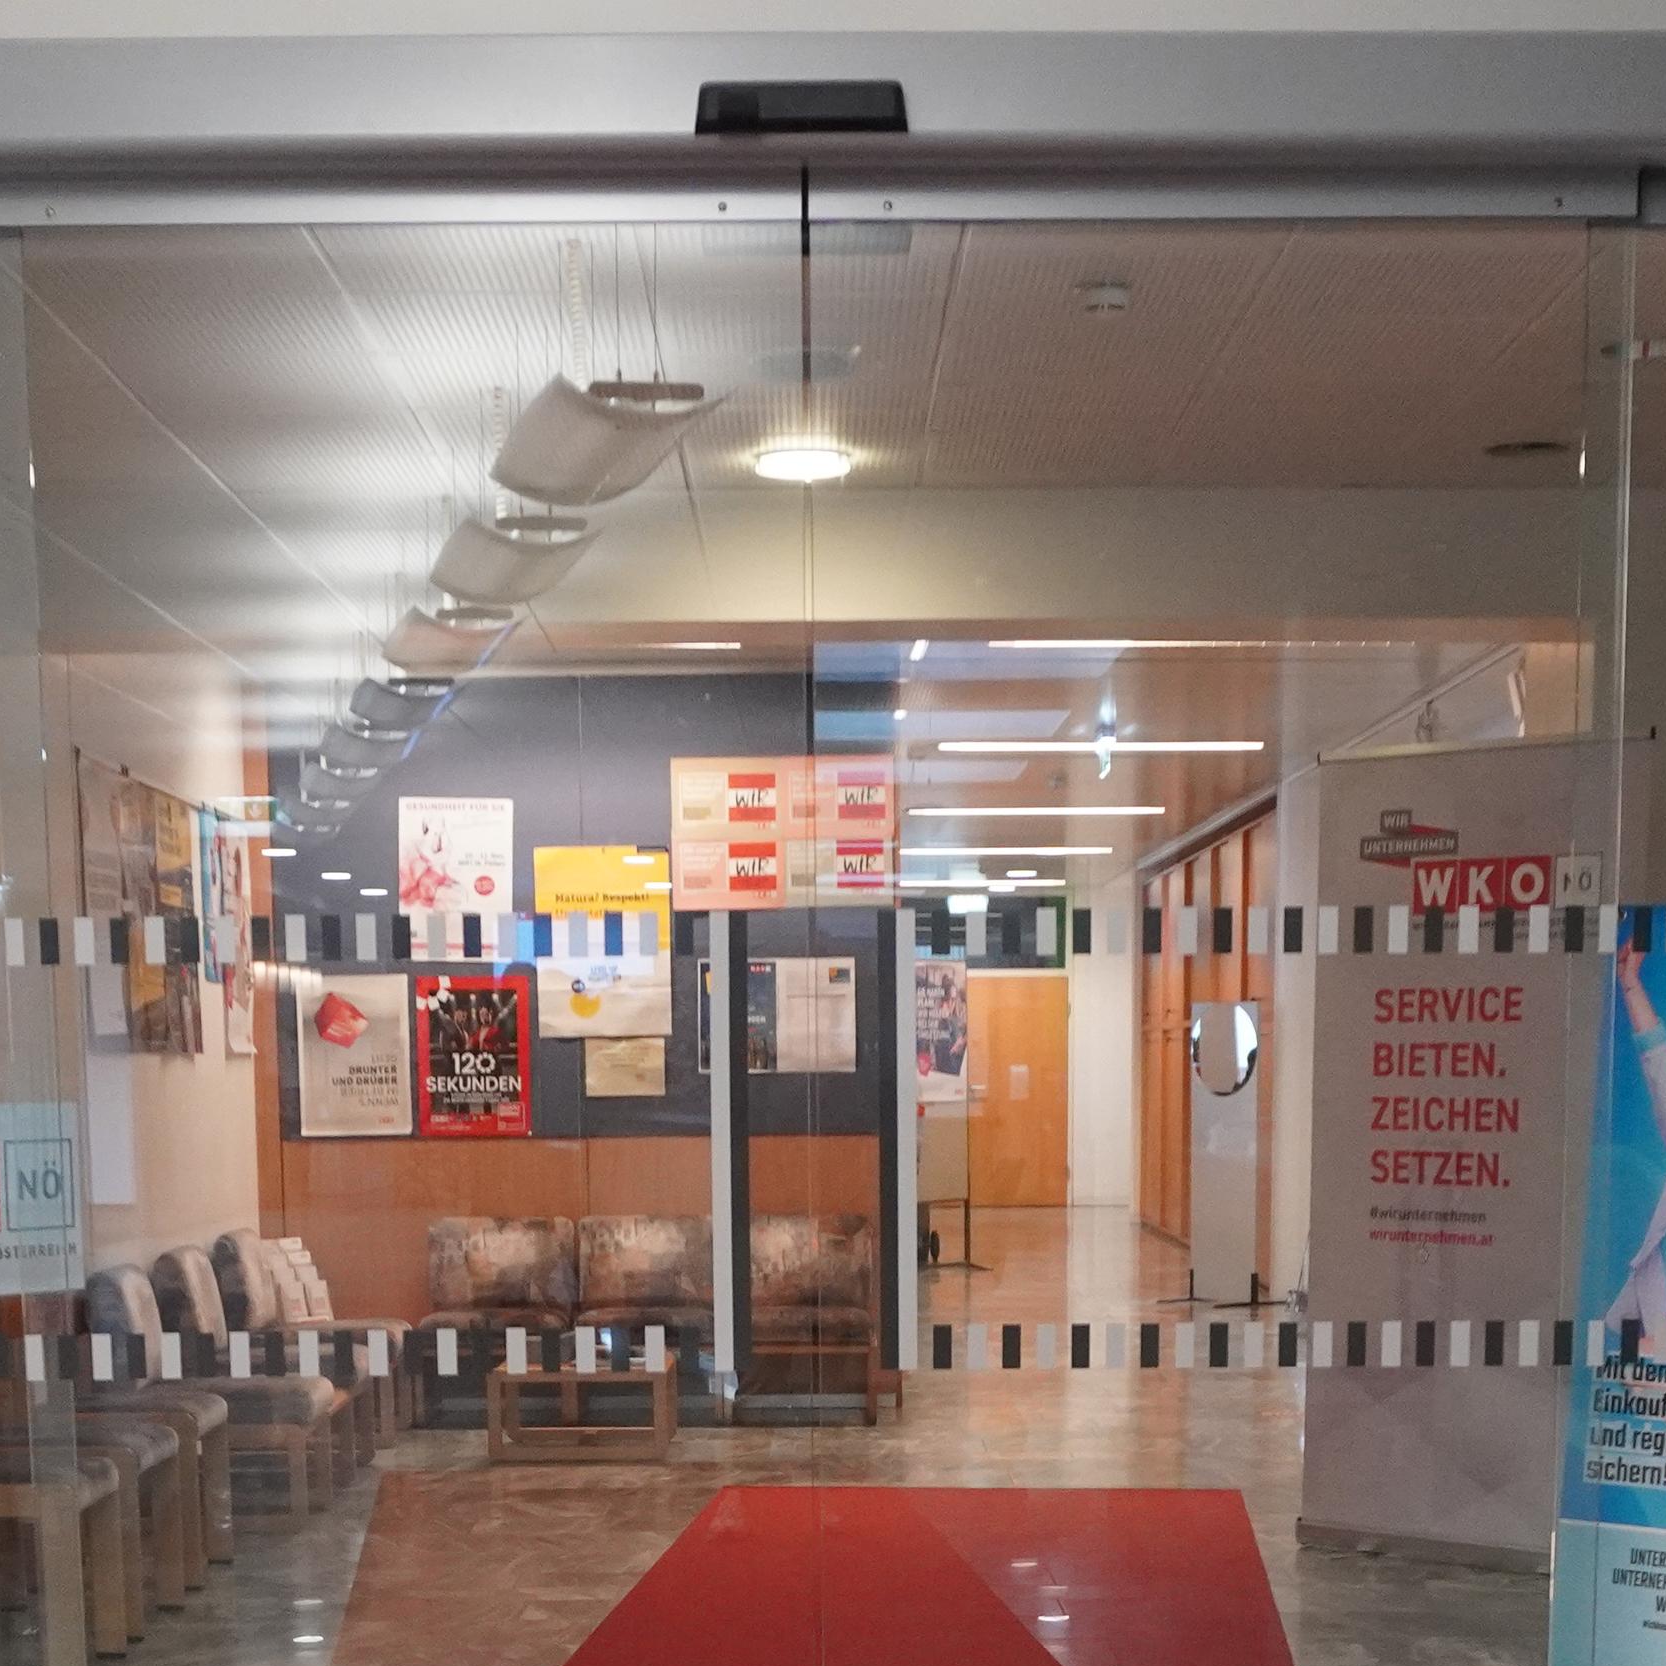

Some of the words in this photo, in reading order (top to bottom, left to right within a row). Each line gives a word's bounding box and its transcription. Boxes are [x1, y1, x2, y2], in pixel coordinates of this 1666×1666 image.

[1418, 863, 1544, 906] WKO
[1374, 987, 1523, 1023] SERVICE
[452, 1052, 496, 1075] 120
[1373, 1042, 1507, 1078] BIETEN.
[426, 1075, 521, 1093] SEKUNDEN
[1371, 1096, 1519, 1133] ZEICHEN
[18, 1160, 62, 1200] NÖ
[1370, 1150, 1510, 1188] SETZEN.
[1370, 1205, 1487, 1224] #wirunternehmen
